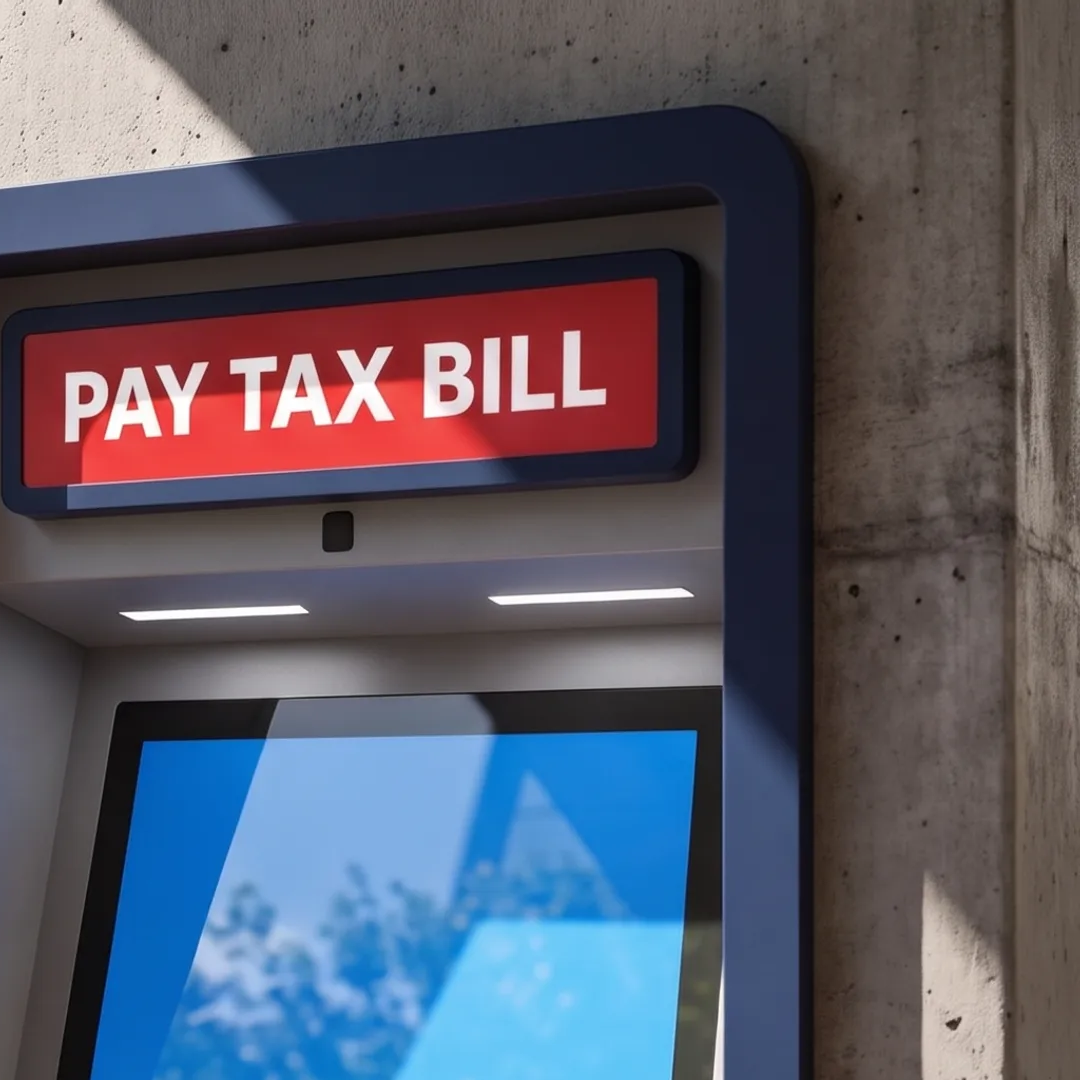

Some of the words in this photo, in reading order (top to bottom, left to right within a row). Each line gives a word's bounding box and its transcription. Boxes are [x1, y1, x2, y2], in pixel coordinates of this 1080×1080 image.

[64, 361, 209, 443] PAY
[229, 346, 395, 432] TAX
[423, 330, 608, 419] BILL
